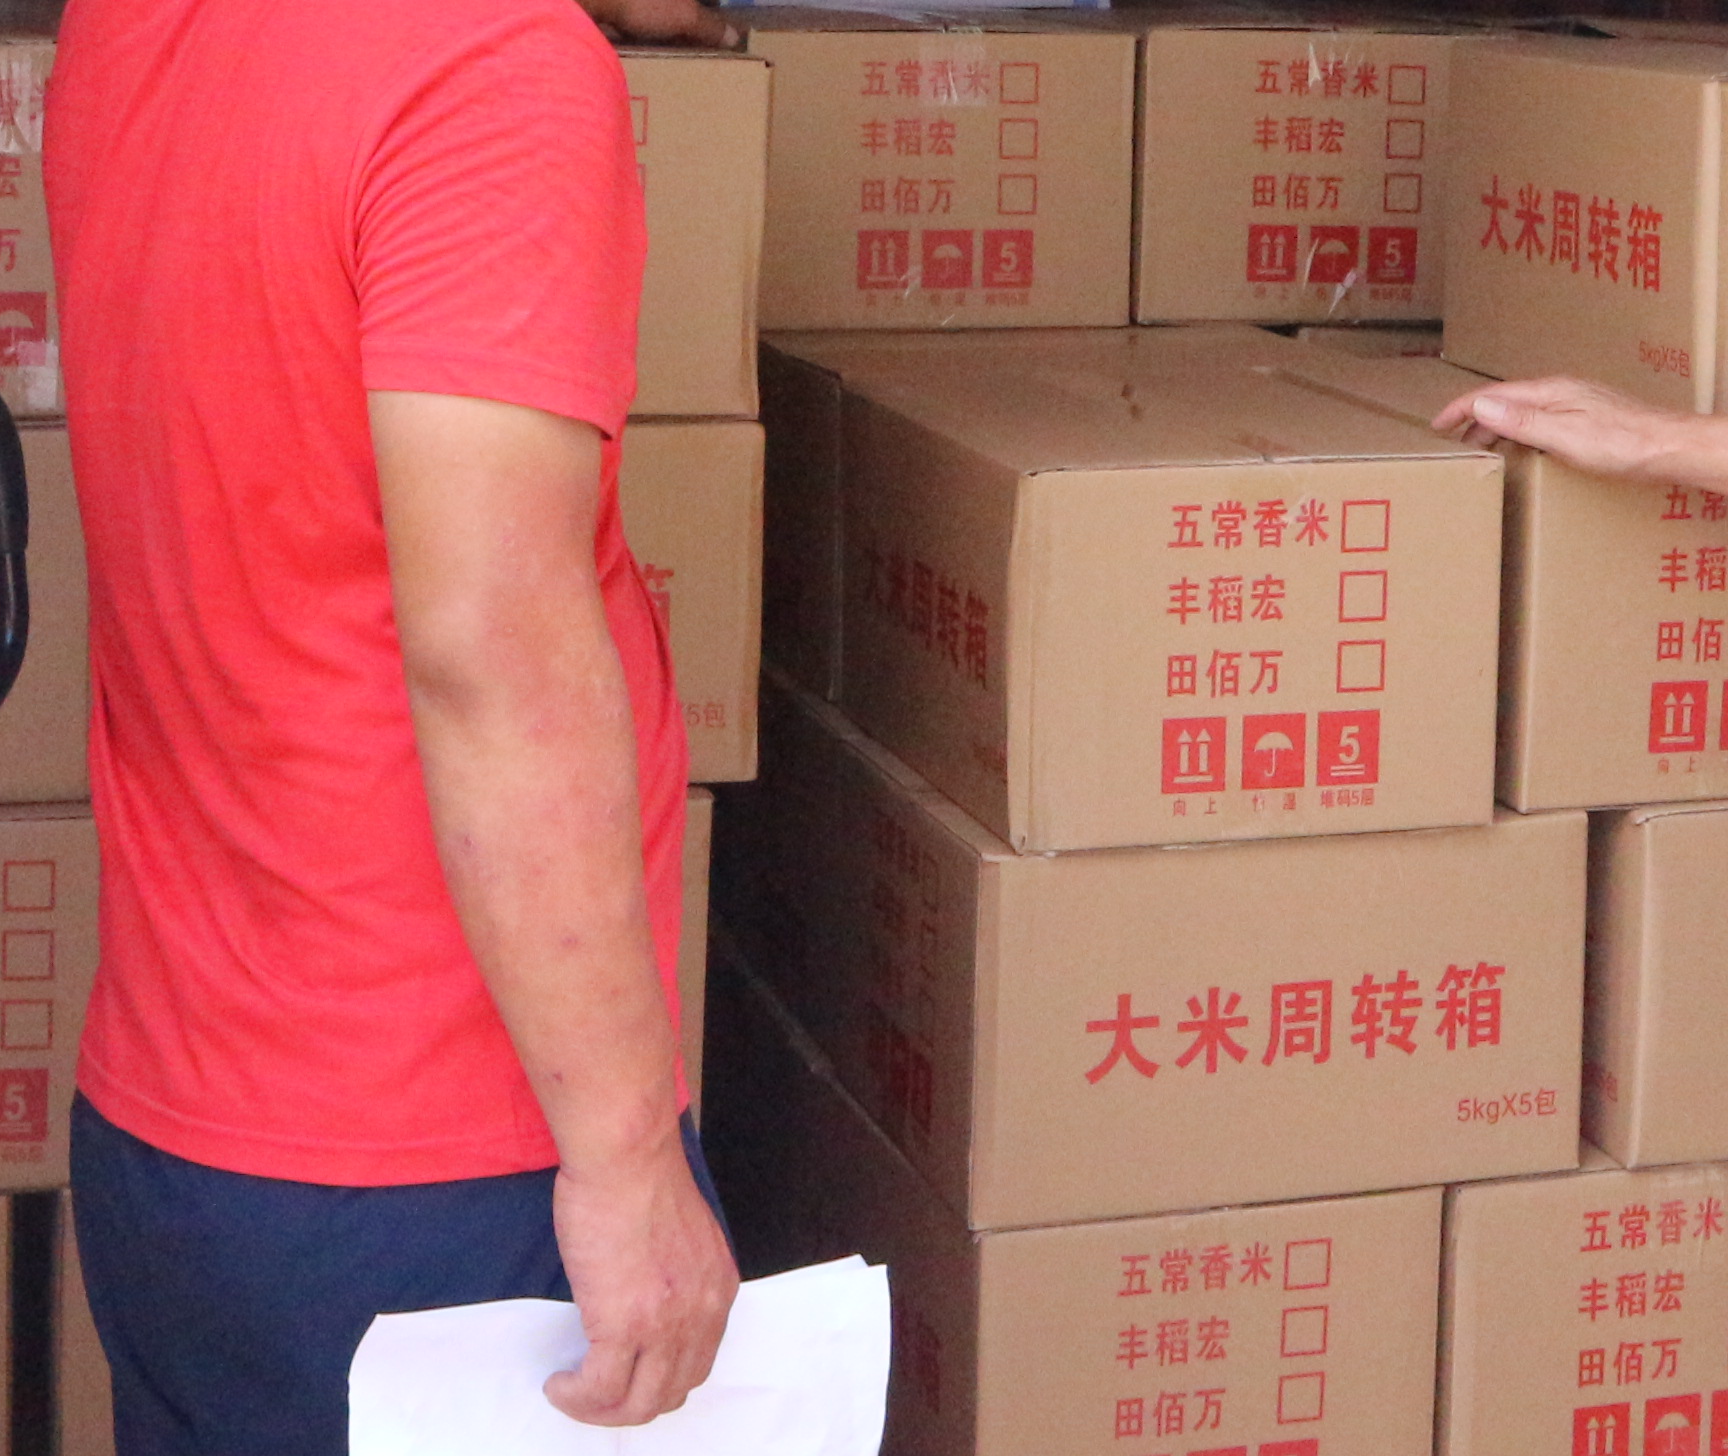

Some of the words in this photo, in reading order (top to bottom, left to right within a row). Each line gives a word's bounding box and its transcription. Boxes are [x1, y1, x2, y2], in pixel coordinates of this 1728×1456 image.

[861, 116, 957, 156] 丰稻宏
[1254, 116, 1345, 155] 丰稻宏
[860, 176, 956, 215] 田佰万
[1252, 173, 1344, 211] 田佰万
[1480, 175, 1664, 293] 大米周转箱
[1168, 498, 1330, 549] 五常香米
[1166, 573, 1287, 625] 丰稻宏
[1166, 649, 1284, 699] 田佰万
[1085, 961, 1507, 1085] 大米周转箱
[1455, 1087, 1560, 1123] 5kgX5包
[1579, 1197, 1725, 1253] 五常香米
[1116, 1241, 1274, 1298] 五常香米
[1578, 1270, 1685, 1322] 丰稻宏
[1115, 1315, 1231, 1370] 丰稻宏
[1577, 1338, 1683, 1389] 田佰万
[1114, 1388, 1227, 1440] 田佰万
